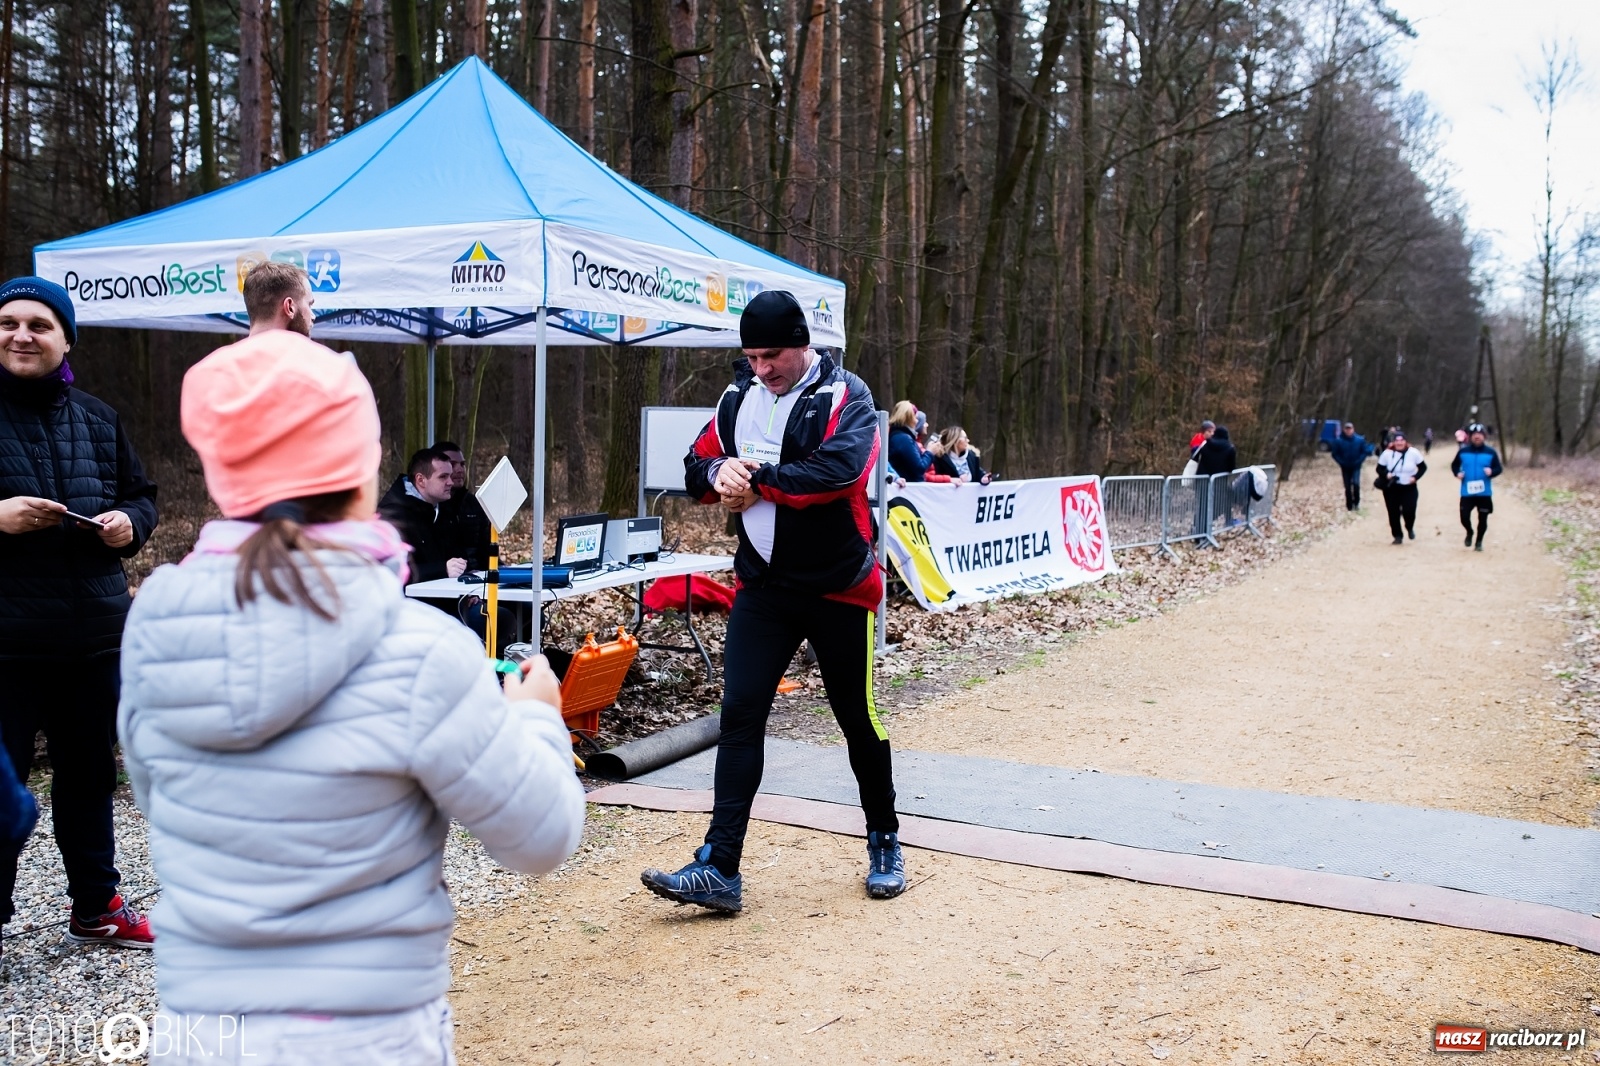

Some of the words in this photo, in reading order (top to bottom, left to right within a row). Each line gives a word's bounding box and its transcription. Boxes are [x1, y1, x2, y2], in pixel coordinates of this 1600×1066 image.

[65, 263, 227, 301] PersonalBest
[451, 264, 506, 284] MITKO
[471, 285, 504, 293] events
[572, 250, 701, 305] PersonalBest
[975, 493, 1016, 524] BIEG
[944, 530, 1051, 574] TWARDZIELA
